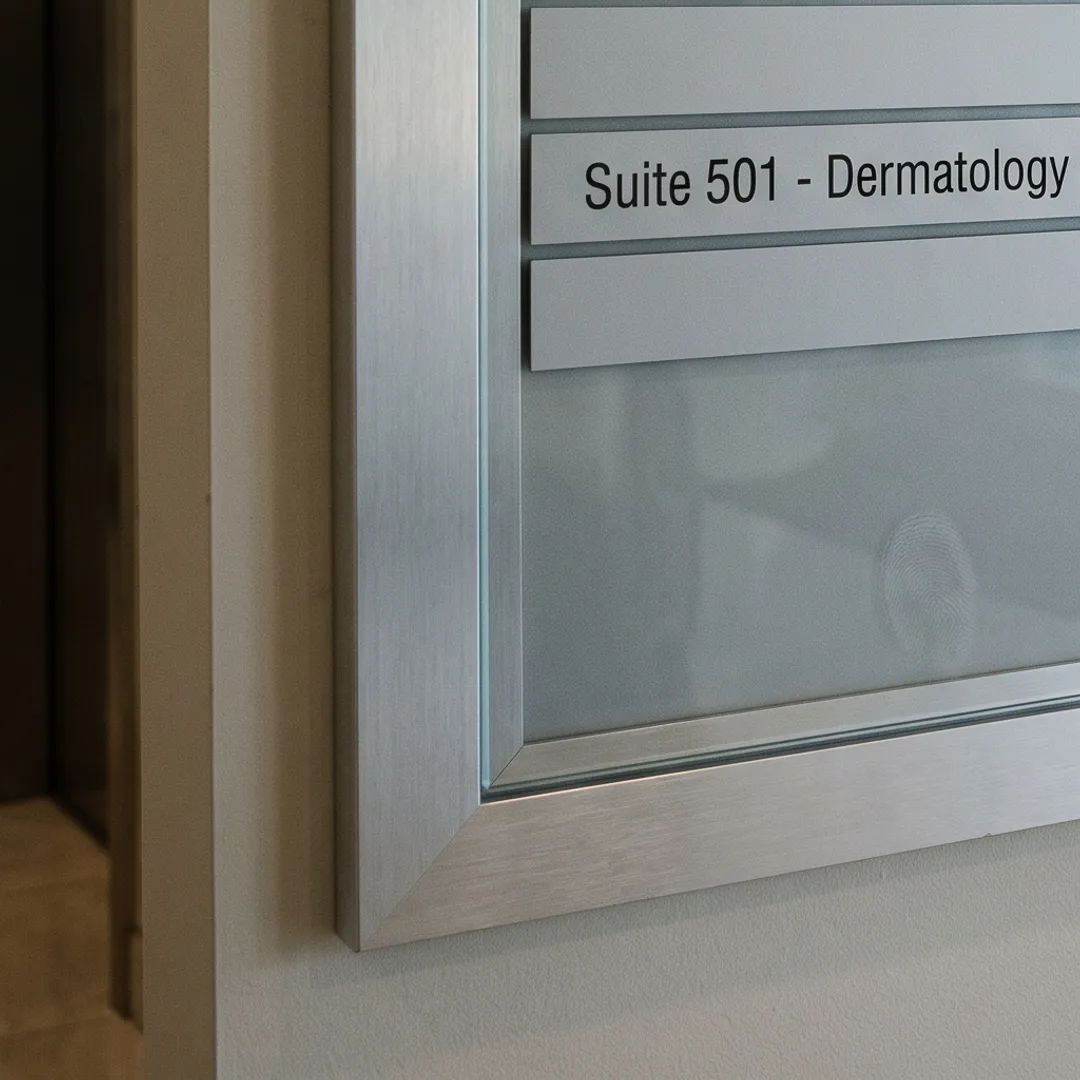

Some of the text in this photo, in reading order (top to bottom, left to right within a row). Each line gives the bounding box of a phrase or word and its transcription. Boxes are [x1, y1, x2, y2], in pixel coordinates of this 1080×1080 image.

[585, 160, 691, 211] Suite
[706, 155, 775, 205] 501
[797, 178, 812, 186] -
[828, 147, 1070, 200] Dermatology
